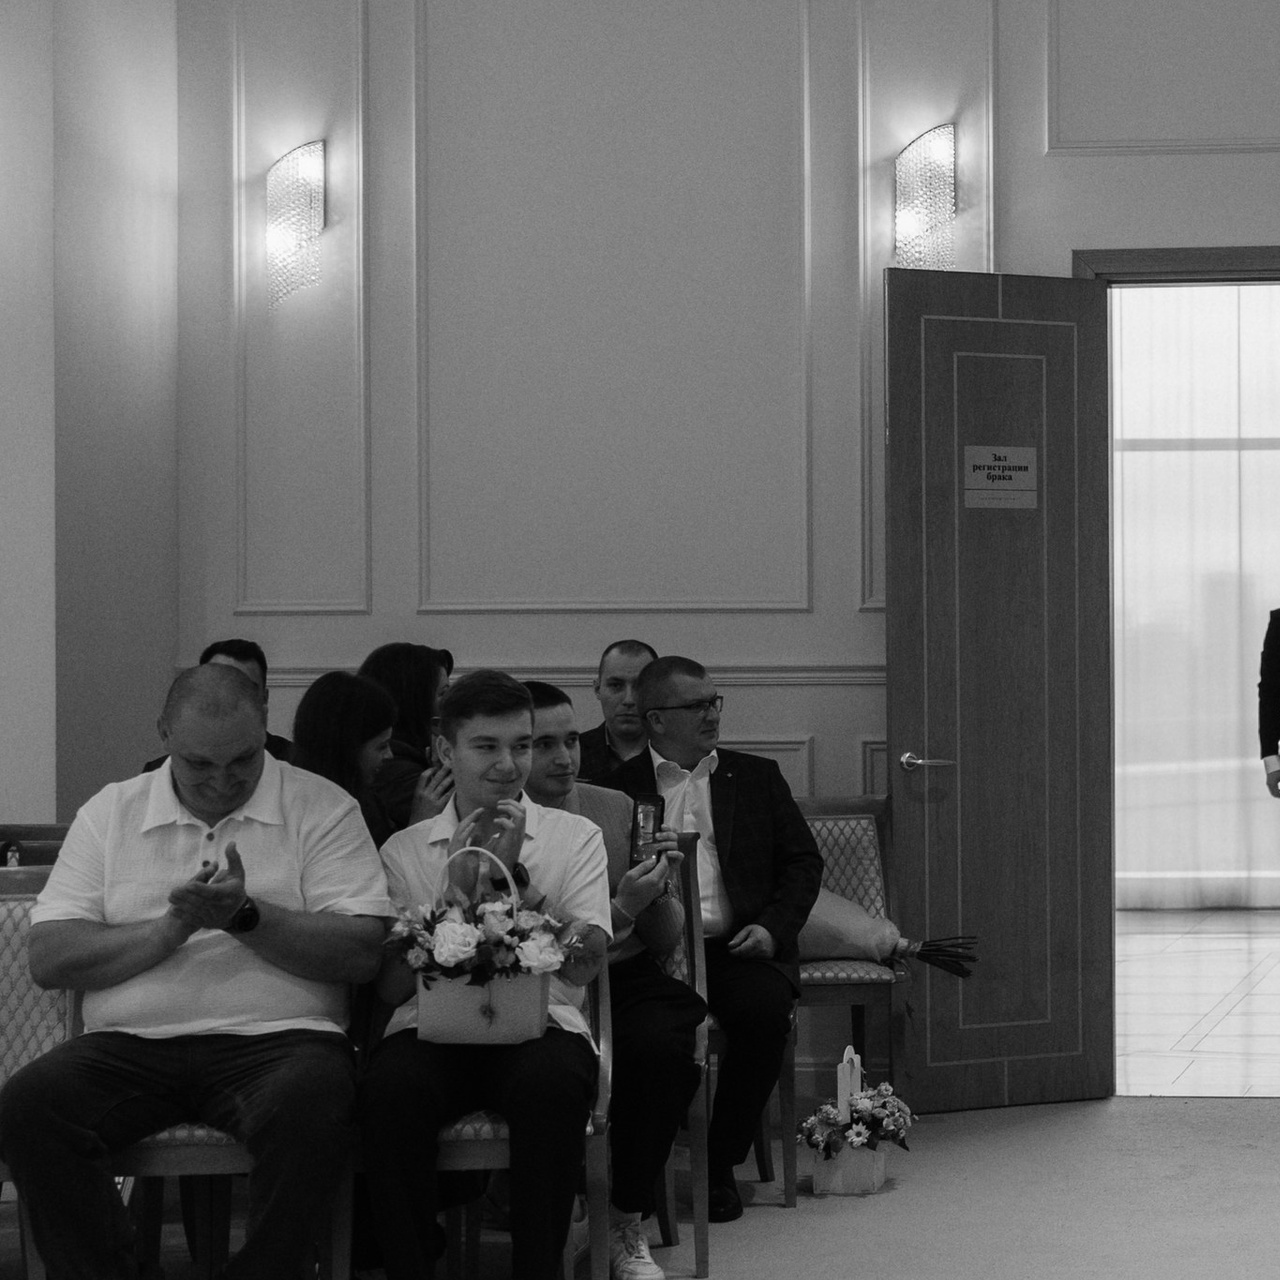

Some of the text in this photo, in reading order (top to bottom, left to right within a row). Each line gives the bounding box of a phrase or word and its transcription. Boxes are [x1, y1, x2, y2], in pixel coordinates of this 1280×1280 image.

[991, 453, 1007, 462] Зал
[972, 464, 1029, 473] регистрации
[986, 472, 1013, 482] брака
